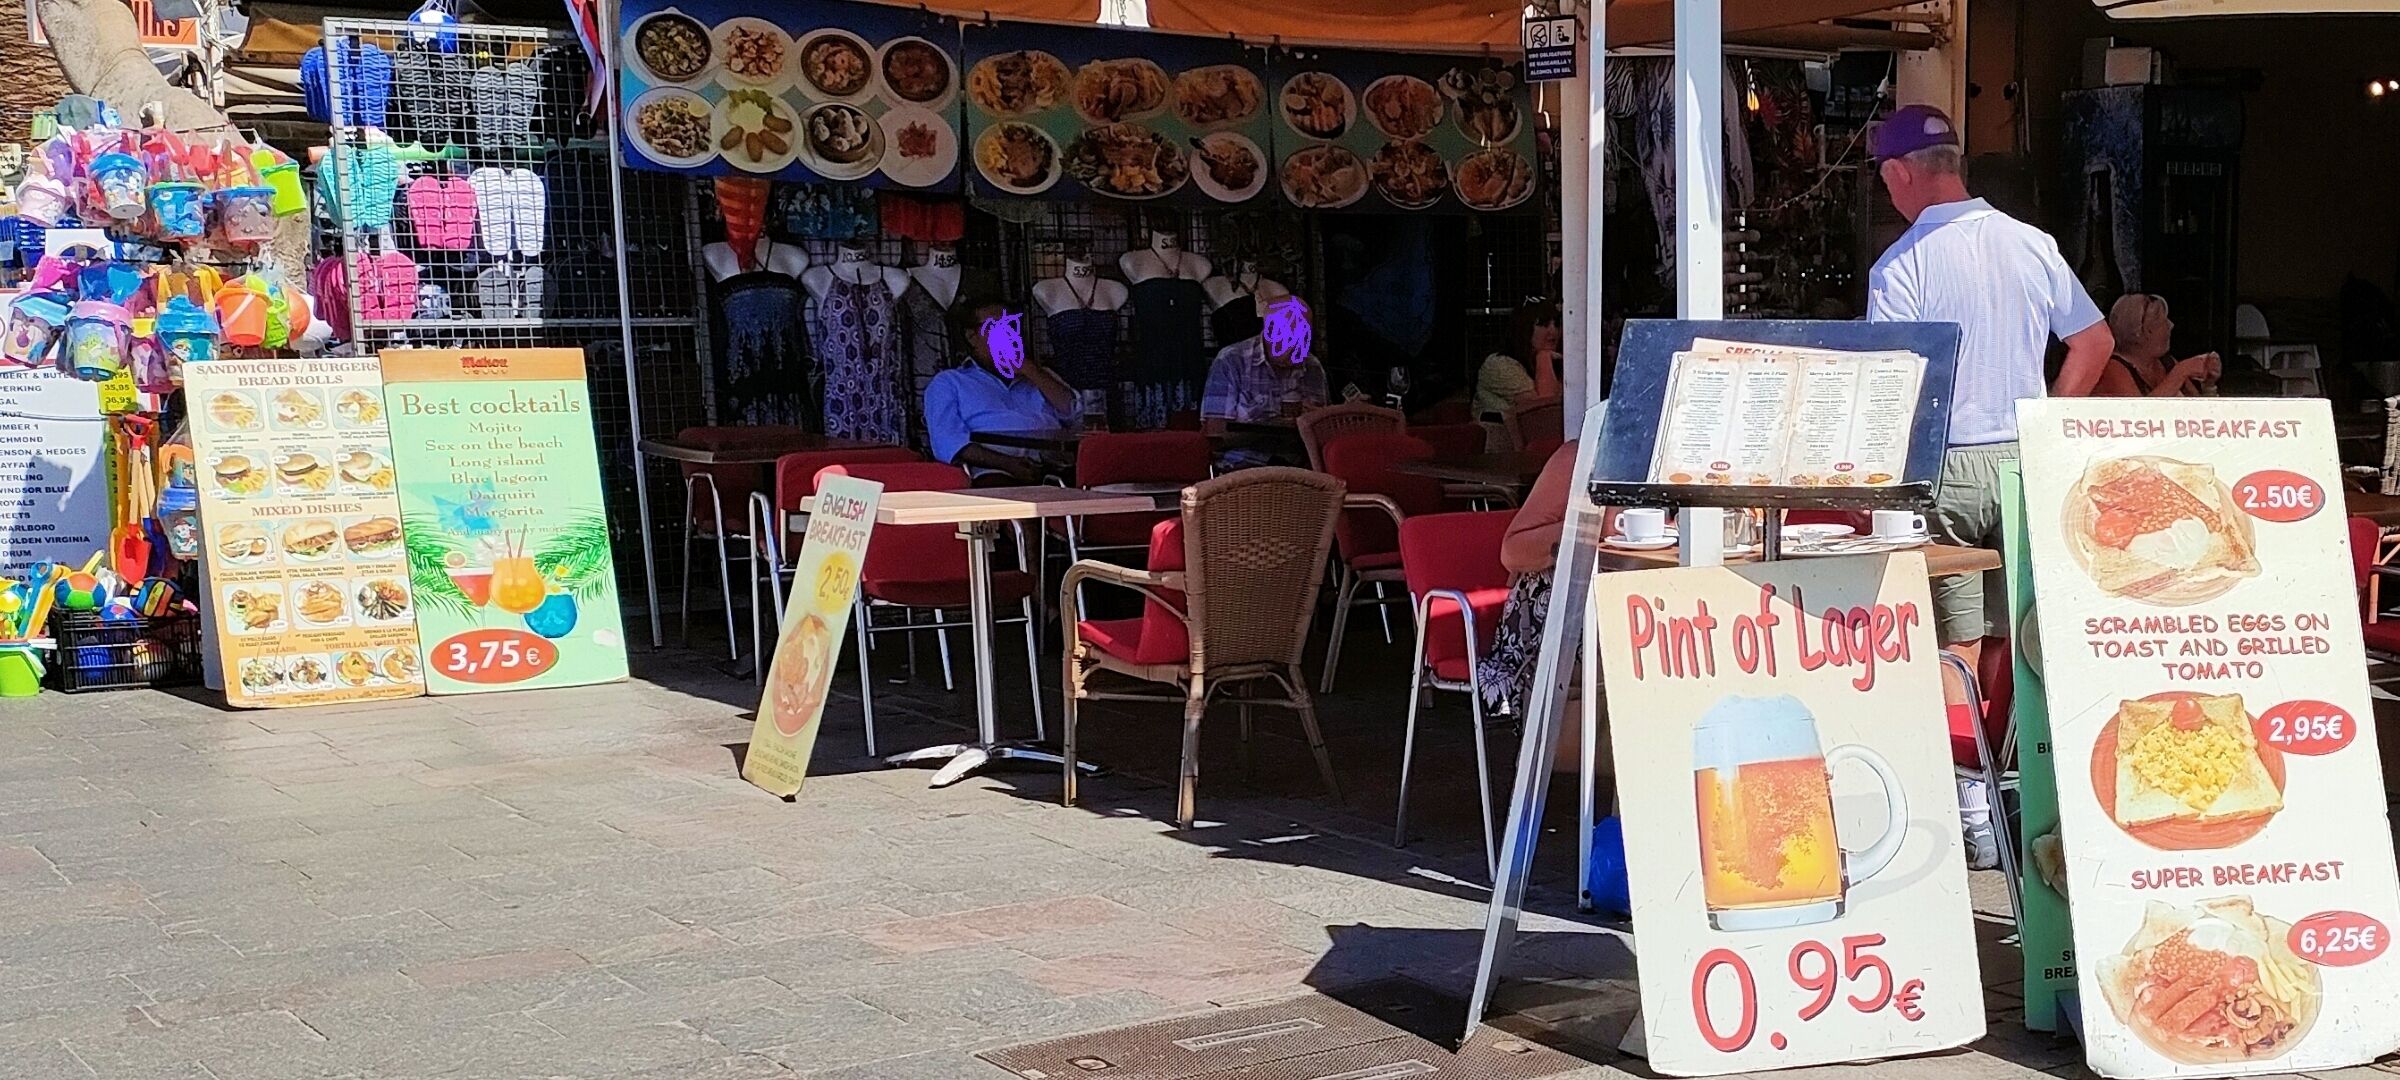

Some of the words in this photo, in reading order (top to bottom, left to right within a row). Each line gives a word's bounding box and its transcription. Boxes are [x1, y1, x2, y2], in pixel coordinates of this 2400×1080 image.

[196, 363, 297, 375] SANDWICHES
[308, 361, 379, 373] BURGERS
[238, 376, 291, 387] BREAD
[294, 374, 344, 385] ROLLS
[400, 393, 460, 416] Best
[470, 388, 581, 415] cocktails
[469, 422, 522, 435] Mojito
[2062, 418, 2166, 439] ENGLISH
[2175, 418, 2302, 439] BREAKFAST
[425, 440, 456, 452] Sex
[461, 441, 481, 450] on
[487, 438, 513, 450] the
[518, 435, 563, 449] beach
[450, 456, 492, 469] Long
[497, 453, 545, 466] island
[451, 473, 489, 485] Blue
[495, 471, 548, 486] lagoon
[45, 486, 71, 494] BLUE
[468, 489, 536, 502] Daiquiri
[2242, 485, 2314, 508] 2.50€
[251, 505, 303, 517] MIXED
[306, 502, 363, 515] DISHES
[465, 506, 544, 518] Margarita
[821, 492, 868, 522] ENGLISH
[0, 524, 55, 532] MARLBORO
[808, 519, 866, 551] BREAKFAST
[1, 537, 42, 545] GOLDEN
[44, 536, 91, 544] VIRGINIA
[2084, 615, 2219, 635] SCRAMBLED
[2228, 614, 2287, 633] EGGS
[2294, 613, 2330, 631] ON
[1626, 593, 1717, 680] Pint
[1731, 582, 1779, 677] of
[1791, 584, 1919, 692] Lager
[2088, 639, 2169, 658] TOAST
[2179, 638, 2228, 657] AND
[2237, 635, 2331, 656] GRILLED
[447, 640, 521, 674] 3,75
[525, 648, 541, 666] €
[2162, 660, 2264, 681] TOMATO
[2268, 714, 2344, 745] 2,95€
[2130, 866, 2205, 890] SUPER
[2212, 861, 2345, 887] BREAKFAST
[2299, 925, 2377, 957] 6,25€
[1691, 932, 1926, 1053] 0.95€
